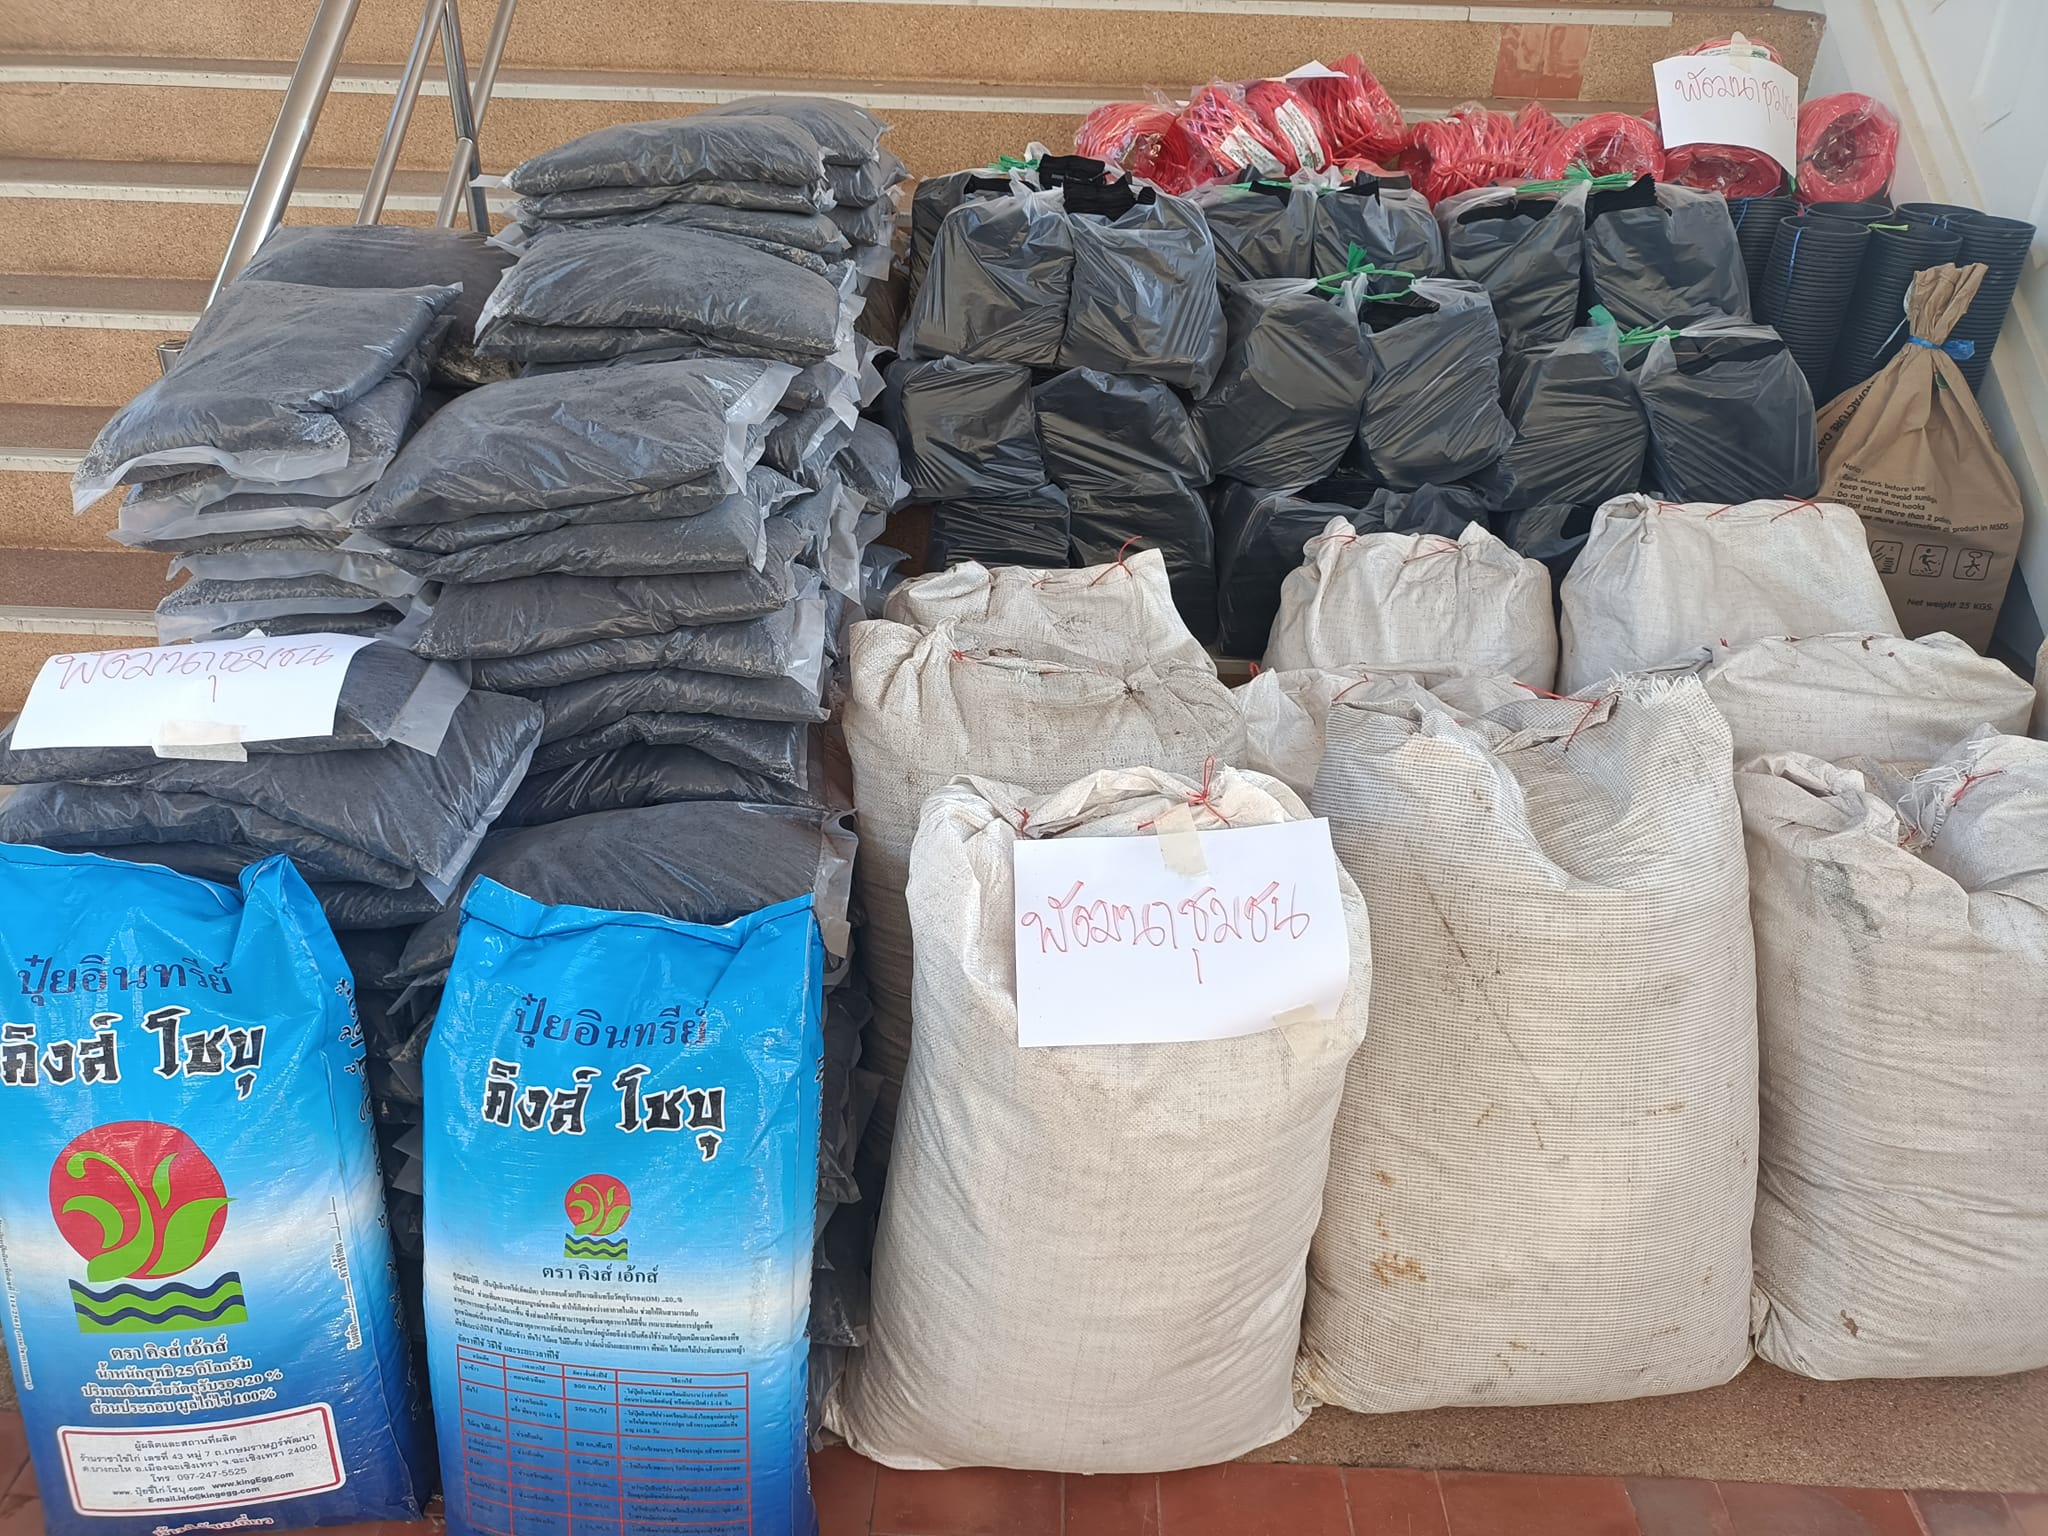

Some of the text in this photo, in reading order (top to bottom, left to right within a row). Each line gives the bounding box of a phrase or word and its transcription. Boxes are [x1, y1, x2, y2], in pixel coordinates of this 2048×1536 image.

[1839, 482, 1858, 491] Keep
[1860, 486, 1872, 494] dry
[1891, 493, 1912, 501] avoid
[1885, 484, 1909, 492] before
[1863, 505, 1882, 514] stack
[1885, 509, 1906, 517] more
[1881, 498, 1900, 507] hand
[1896, 520, 1941, 531] information
[1951, 525, 1979, 533] product
[1980, 523, 1988, 531] in
[1907, 598, 1924, 606] Net
[1926, 601, 1957, 609] weight
[1021, 880, 1311, 985] พัฒนาชุมชน
[18, 953, 233, 1007] ปุ๋ยอินทรีย์
[513, 992, 709, 1050] ปุ๋ยอินทรีย์
[0, 1013, 122, 1087] คิงส์
[142, 1006, 266, 1101] โชบุ
[482, 1058, 726, 1162] คิงส์ โชบุ
[542, 1263, 659, 1285] ตรา คิงส์ เอ้กส์
[110, 1333, 228, 1361] ตรา คิงส์ เอ้กส์
[96, 1356, 252, 1382] น้ำหนักสุทธิ 25 กิโลกรัม
[245, 1373, 263, 1386] 20
[91, 1387, 277, 1415] ส่วนประกอบ มูลไก่ไข่ 100%
[134, 1434, 237, 1451] ผู้ผลิตและสถานที่ผลิต
[287, 1443, 317, 1455] 24000
[144, 1450, 169, 1462] เลขที่
[188, 1449, 202, 1460] หมู่
[177, 1467, 248, 1481] 097-247-5525
